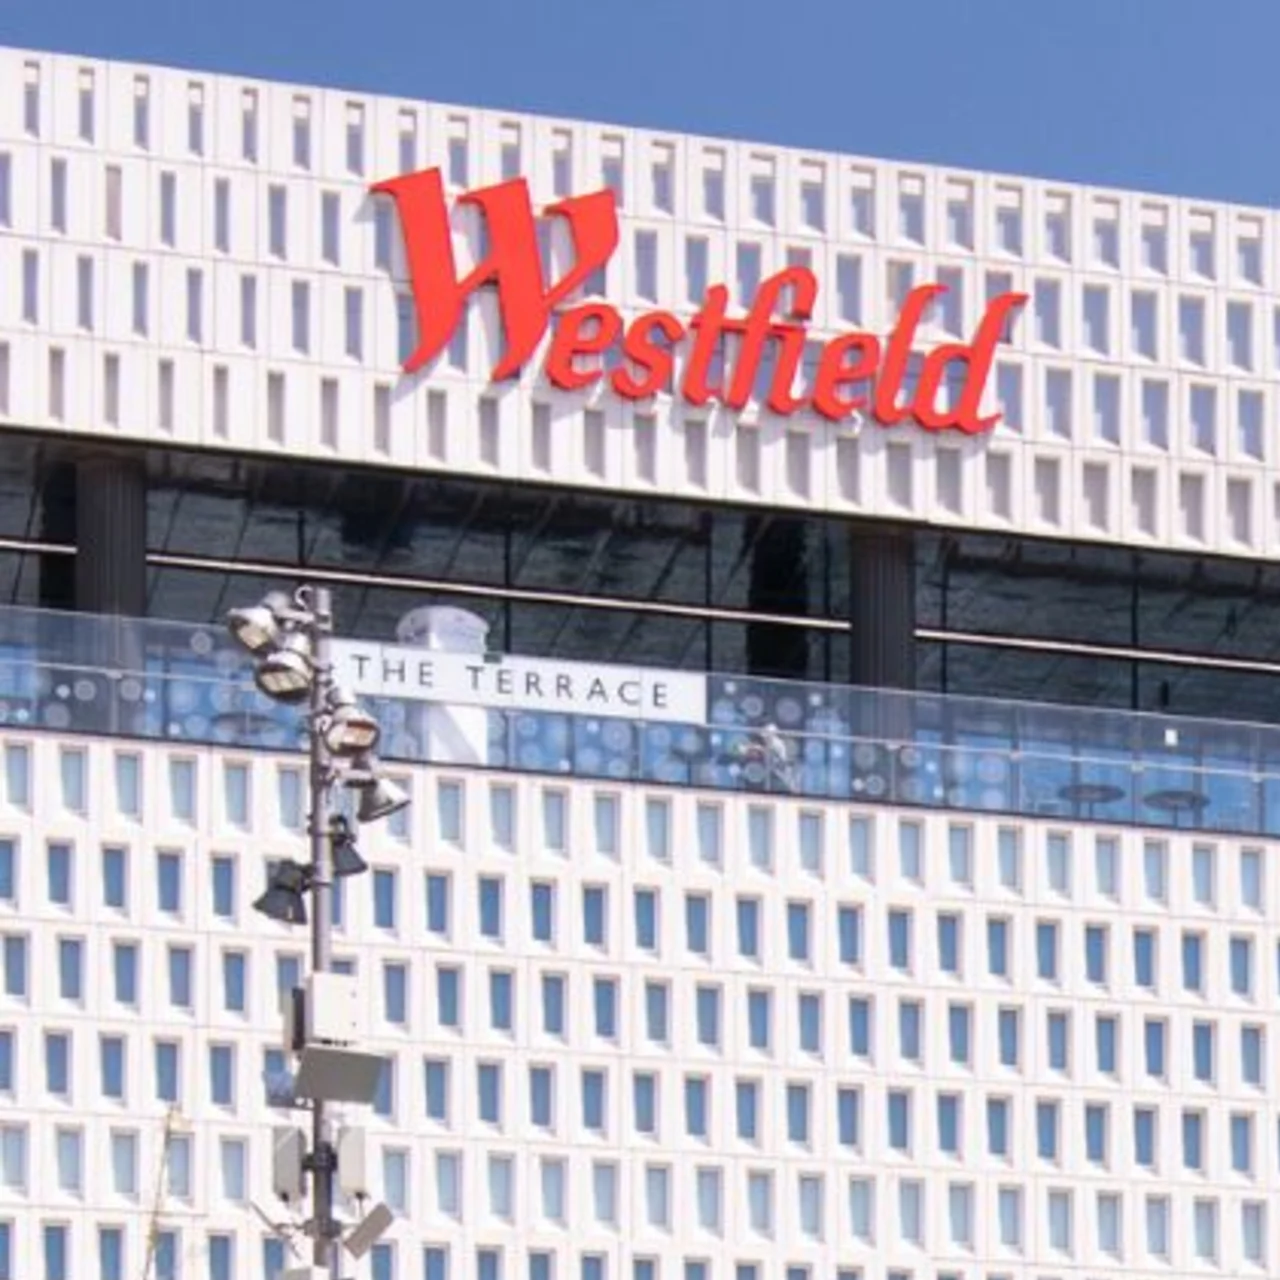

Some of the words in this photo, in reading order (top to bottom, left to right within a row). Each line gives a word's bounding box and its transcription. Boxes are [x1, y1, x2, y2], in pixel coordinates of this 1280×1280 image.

[369, 166, 1029, 435] Westfield
[351, 653, 434, 688] THE
[466, 665, 669, 708] TERRACE
